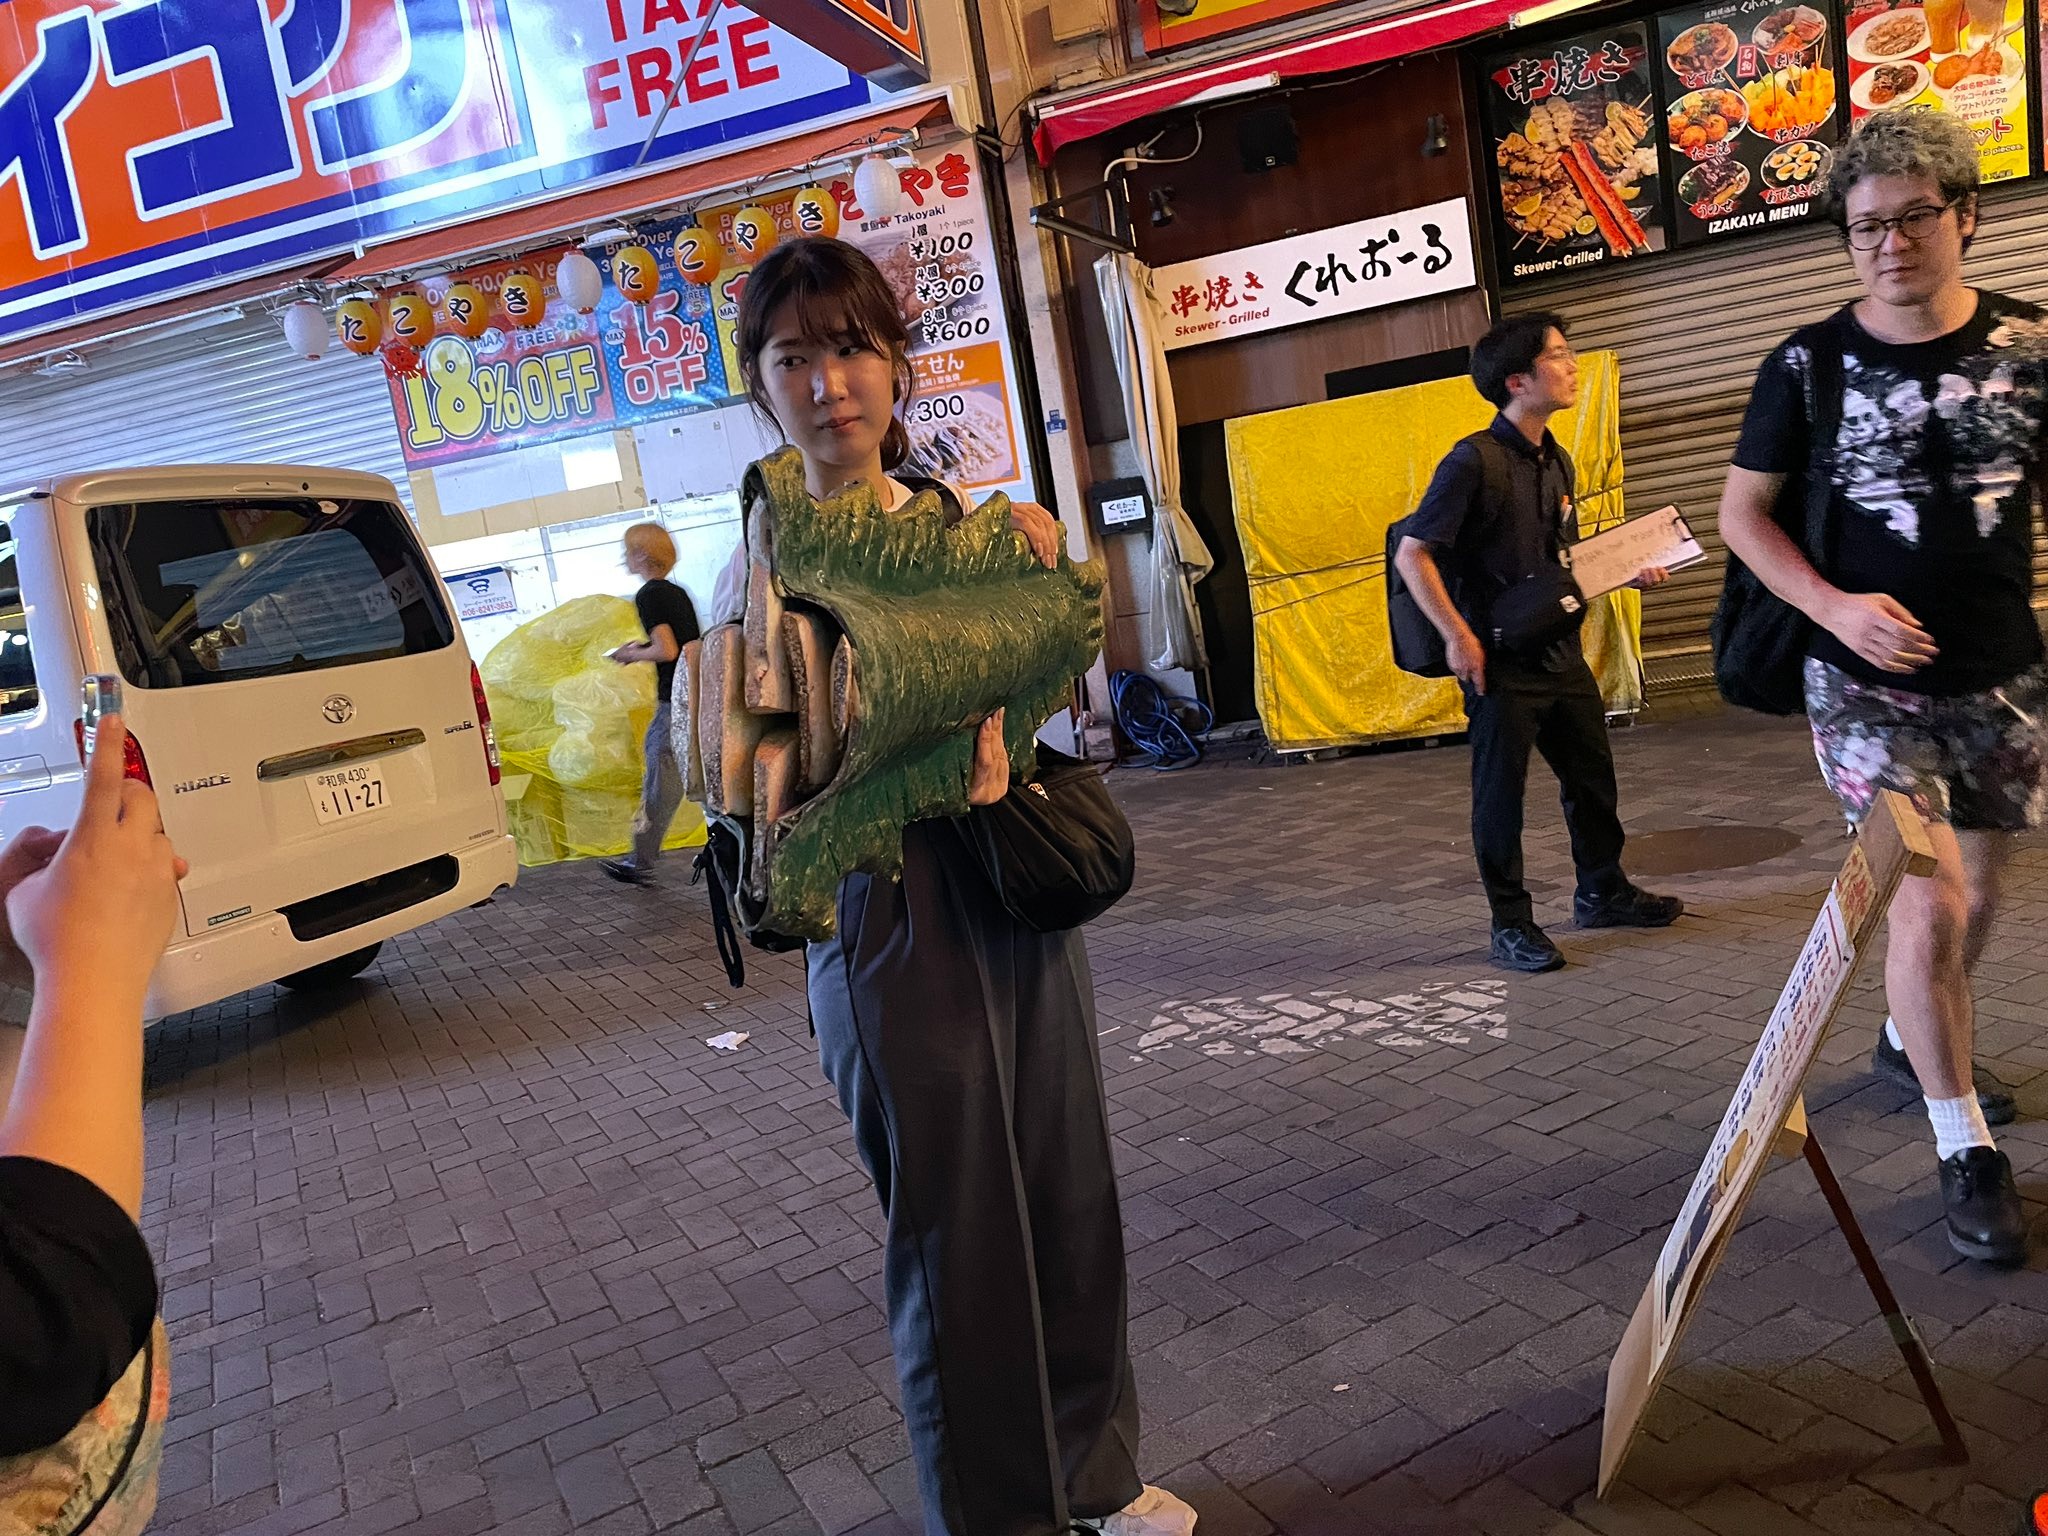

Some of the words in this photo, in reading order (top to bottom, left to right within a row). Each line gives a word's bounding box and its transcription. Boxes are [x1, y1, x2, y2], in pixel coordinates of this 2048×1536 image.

[583, 17, 781, 130] FREE
[1505, 40, 1629, 104] 串焼き
[829, 153, 971, 221] たやき
[895, 205, 946, 225] Takoyaki
[1708, 211, 1766, 234] IZAKAYA
[1769, 203, 1810, 222] MENU
[910, 231, 973, 260] ¥100
[1170, 271, 1264, 319] 串焼き
[1285, 223, 1452, 307] くれおーる
[1513, 247, 1604, 276] Skewer-Grilled
[917, 274, 984, 303] ¥300
[606, 330, 626, 342] MAX
[609, 289, 709, 369] 15%
[924, 317, 990, 344] ¥600
[1175, 307, 1270, 337] Skewer-Grilled
[476, 331, 505, 351] MAX
[516, 329, 556, 349] FREE
[625, 354, 707, 405] OFF
[912, 353, 965, 378] こせん
[174, 771, 232, 794] HIACE
[325, 772, 349, 788] 和泉
[348, 767, 367, 783] 430
[331, 780, 382, 816] 11-27
